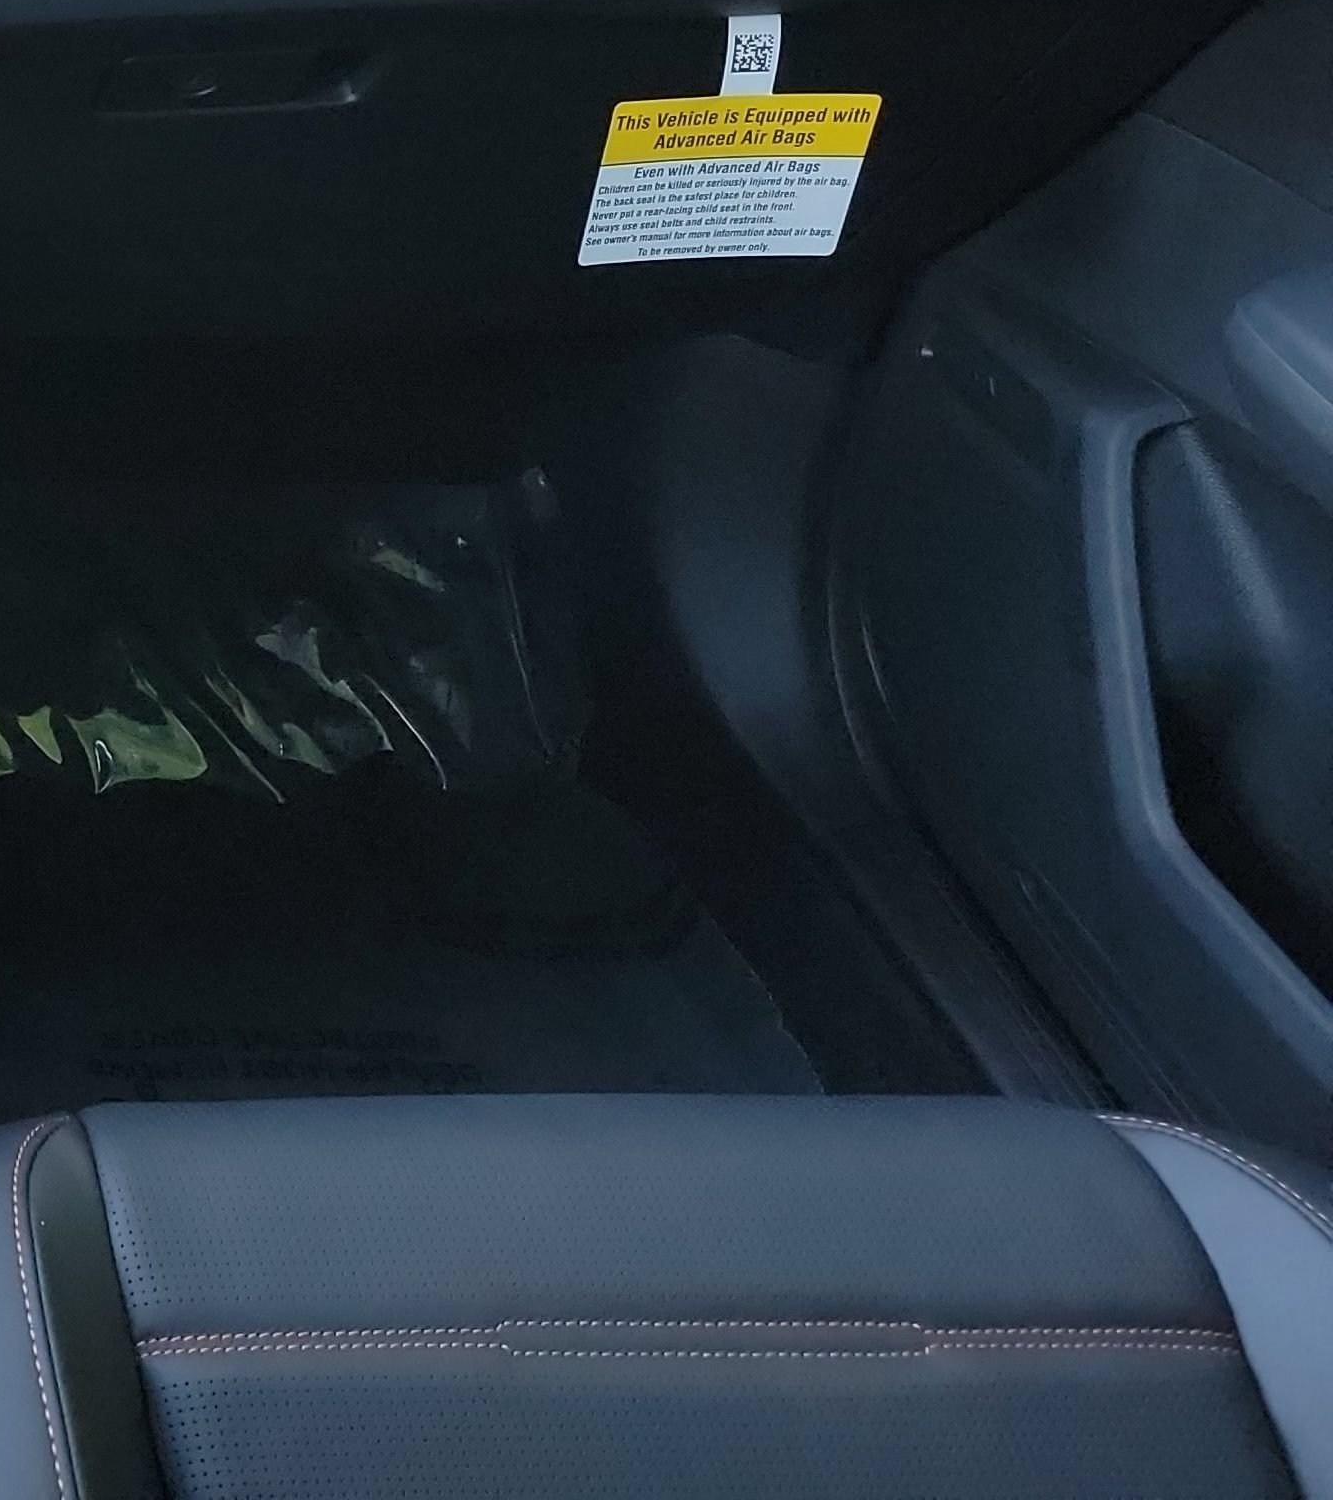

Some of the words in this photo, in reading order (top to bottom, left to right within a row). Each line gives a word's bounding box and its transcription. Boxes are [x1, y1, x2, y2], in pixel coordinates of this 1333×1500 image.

[617, 115, 651, 131] This
[657, 110, 718, 127] Vehicle
[725, 109, 739, 123] is
[744, 108, 828, 125] Equipped
[833, 108, 870, 122] with
[653, 130, 736, 149] Advanced
[741, 130, 767, 144] Air
[772, 129, 816, 147] Bags
[634, 167, 664, 178] Even
[668, 164, 694, 176] with
[698, 161, 761, 174] Advanced
[764, 161, 784, 172] Air
[788, 161, 820, 174] Bags
[598, 185, 634, 195] Children
[637, 184, 652, 192] can
[655, 182, 666, 190] be
[668, 180, 692, 189] killed
[706, 178, 747, 188] seriously
[749, 177, 782, 187] injured
[784, 177, 797, 187] by
[797, 177, 811, 185] the
[814, 177, 827, 186] air
[829, 178, 850, 187] bag.
[596, 199, 611, 208] The
[614, 197, 633, 206] back
[636, 195, 656, 204] seat
[658, 195, 666, 203] is
[668, 193, 682, 202] the
[685, 192, 712, 201] safest
[714, 191, 739, 200] place
[742, 190, 755, 199] for
[757, 189, 798, 198] children.
[592, 212, 617, 220] Never
[619, 210, 634, 220] put
[644, 206, 693, 216] rear-facing
[695, 204, 717, 213] child
[720, 203, 740, 212] seat
[742, 203, 751, 211] in
[753, 203, 768, 211] the
[771, 202, 795, 211] front.
[588, 224, 620, 233] Always
[640, 220, 659, 229] seat
[661, 219, 683, 228] belts
[685, 218, 702, 226] and
[704, 217, 727, 225] child
[729, 215, 775, 224] restraints.
[585, 238, 602, 246] See
[604, 235, 637, 244] owner's
[639, 232, 672, 242] manual
[674, 231, 686, 239] for
[713, 228, 764, 237] information
[767, 228, 792, 236] about
[794, 228, 807, 236] air
[809, 228, 834, 237] bags.
[638, 248, 647, 256] To
[650, 247, 661, 255] be
[663, 245, 703, 255] removed
[705, 244, 715, 254] by
[717, 244, 746, 252] owner
[748, 243, 770, 252] only.
